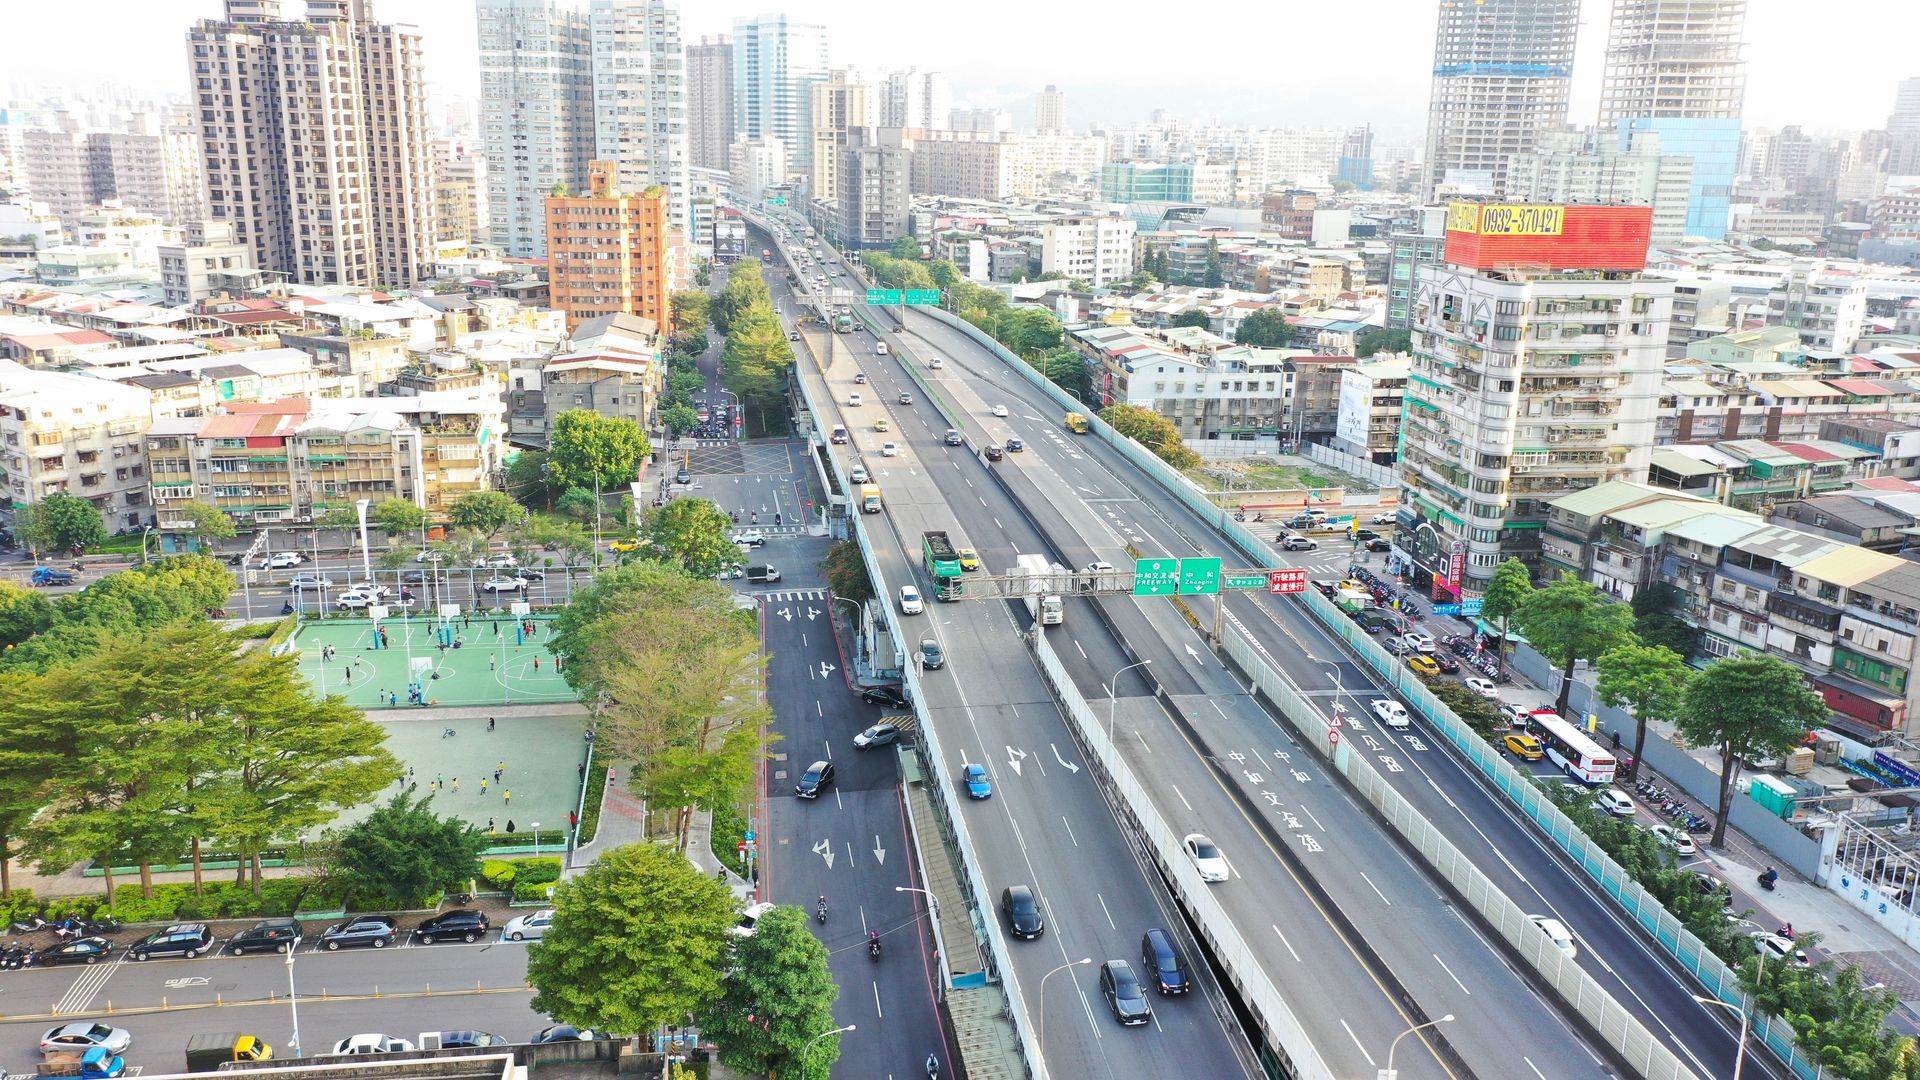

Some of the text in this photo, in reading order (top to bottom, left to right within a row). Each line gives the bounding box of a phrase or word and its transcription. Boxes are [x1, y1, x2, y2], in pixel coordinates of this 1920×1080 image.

[1483, 208, 1559, 233] 0932-370421
[1272, 582, 1304, 592] 減速慢行
[1273, 572, 1305, 582] 行駛路肩
[1274, 749, 1312, 783] 中和
[1228, 750, 1324, 852] 中和交流道
